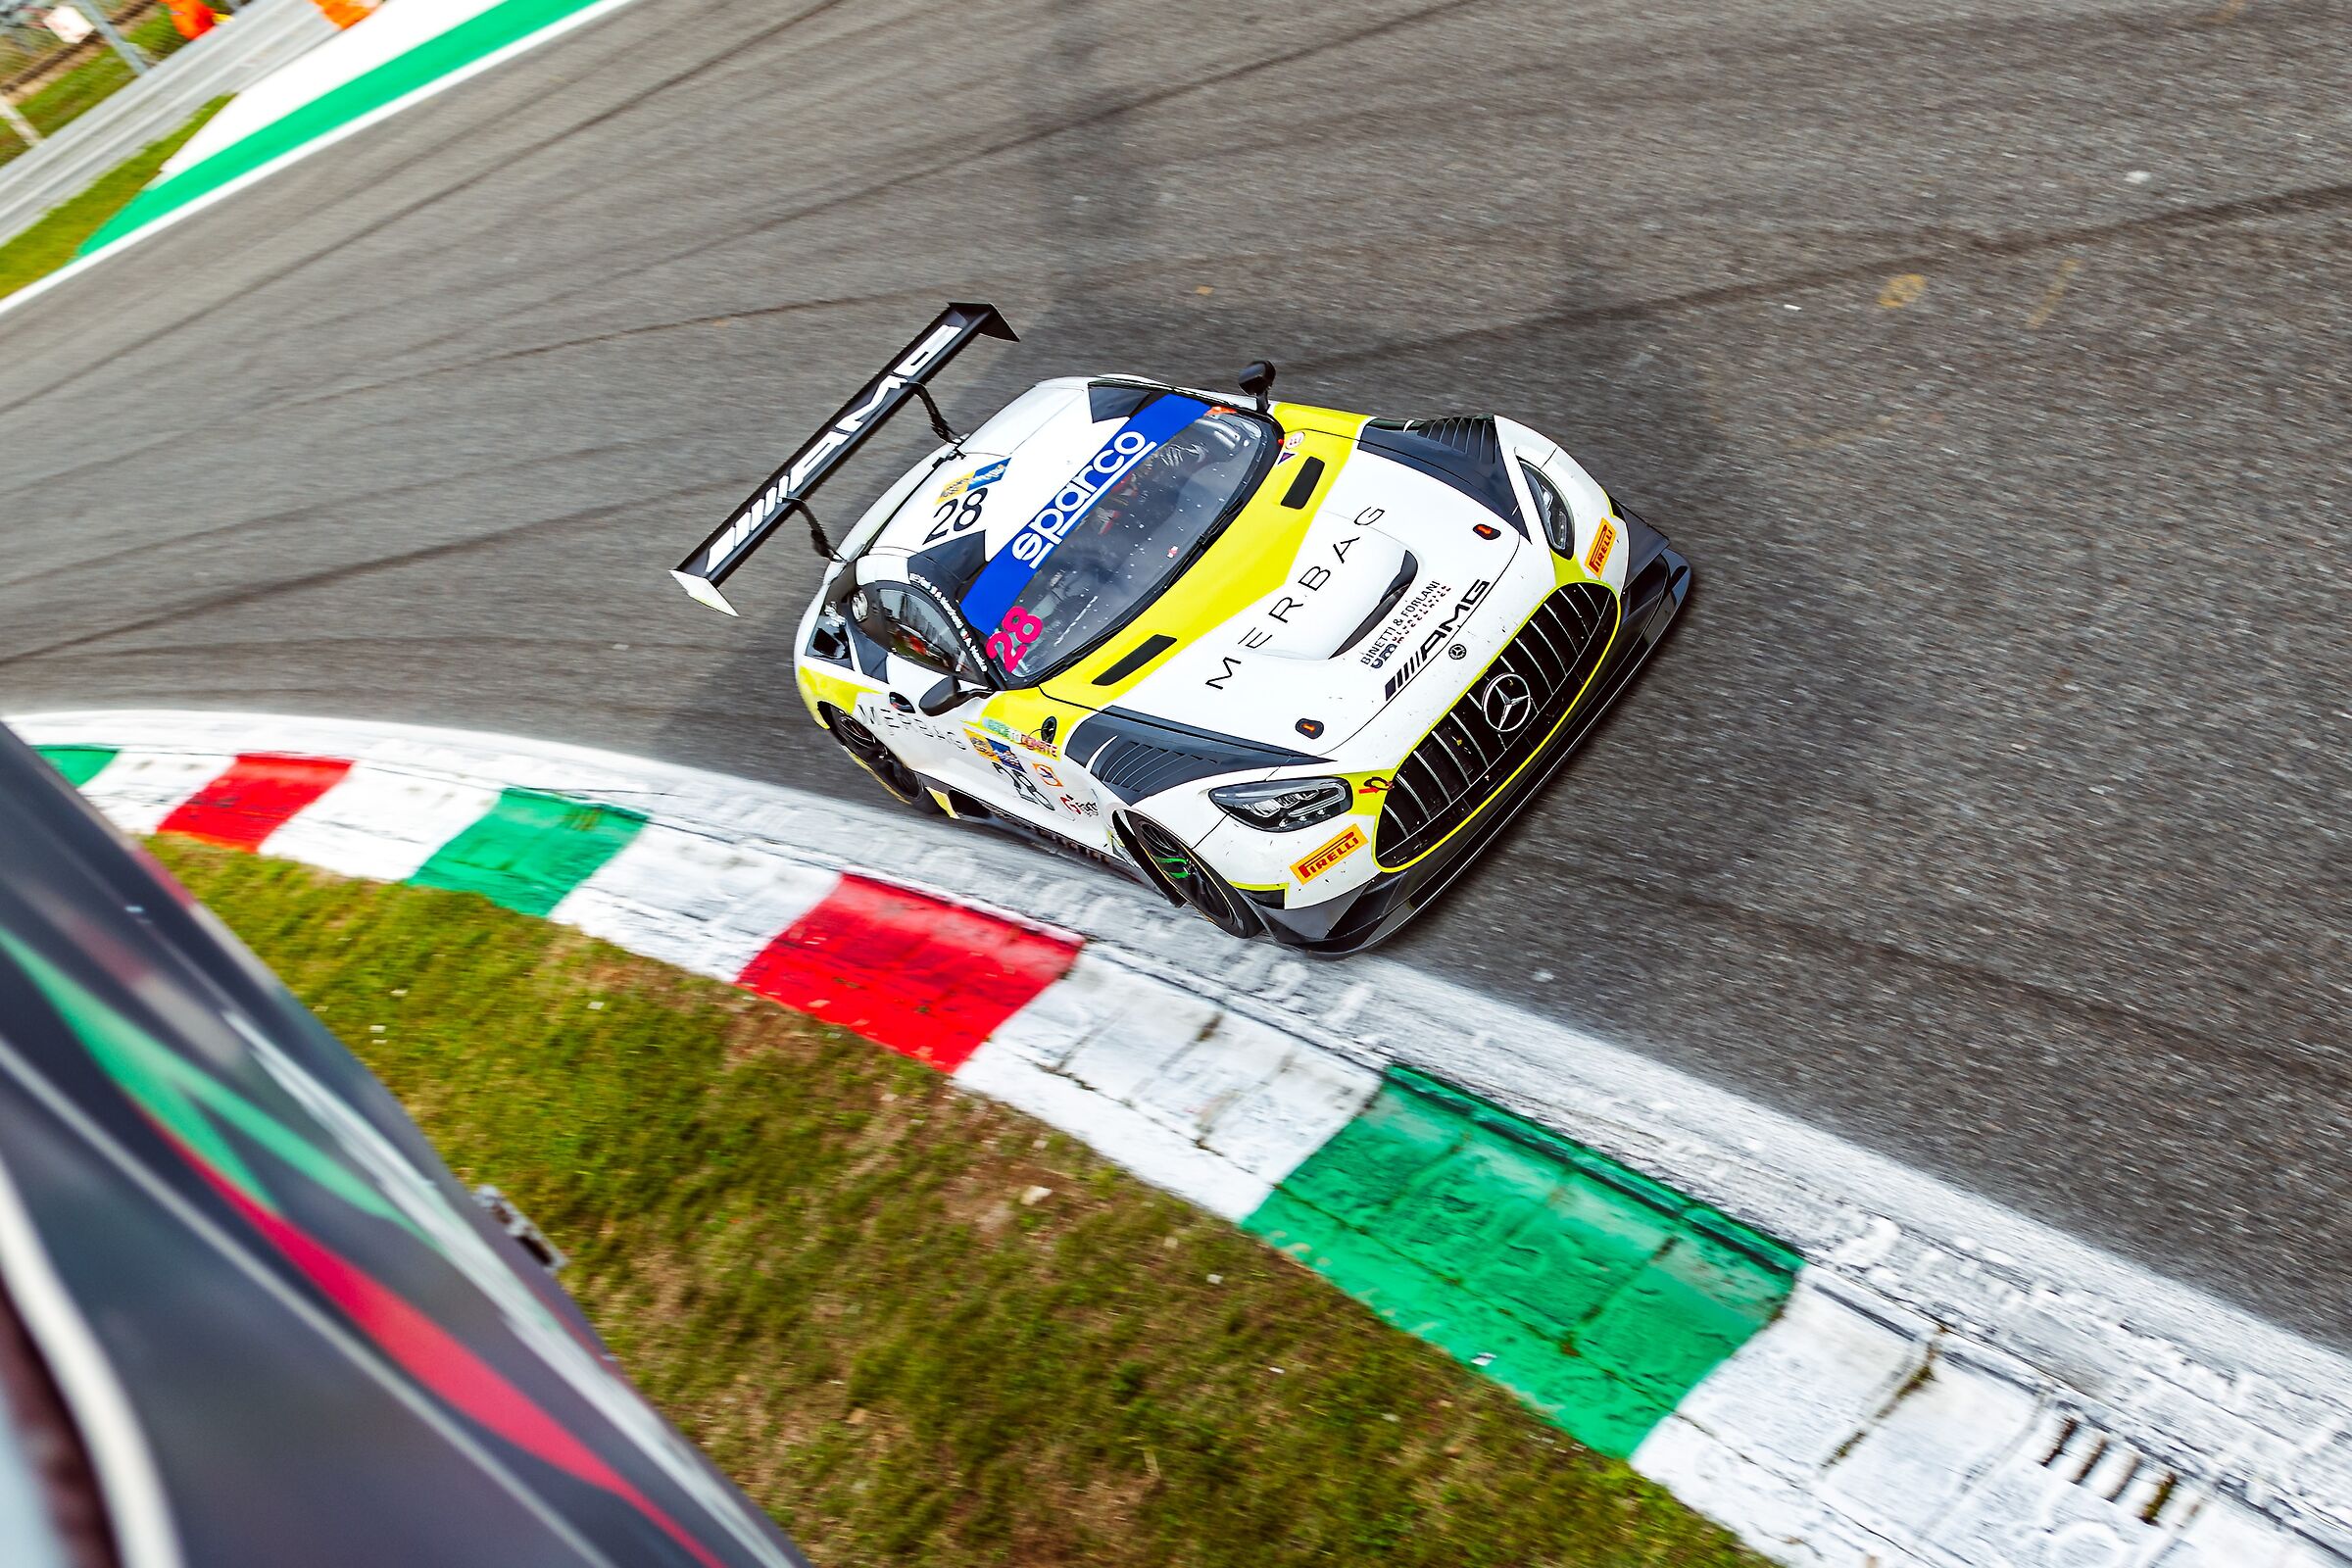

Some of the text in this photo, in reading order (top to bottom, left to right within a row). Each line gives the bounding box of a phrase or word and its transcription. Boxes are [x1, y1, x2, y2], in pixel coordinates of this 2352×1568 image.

[922, 487, 988, 545] 28
[1012, 431, 1147, 562] sparco
[1589, 524, 1613, 573] PIRELLI
[1205, 507, 1385, 690] MERBAG
[1360, 626, 1396, 665] BINETTI
[1400, 581, 1441, 617] FORLANI
[986, 606, 1044, 673] 28
[992, 761, 1055, 811] 28
[1298, 831, 1359, 879] PIRELLI
